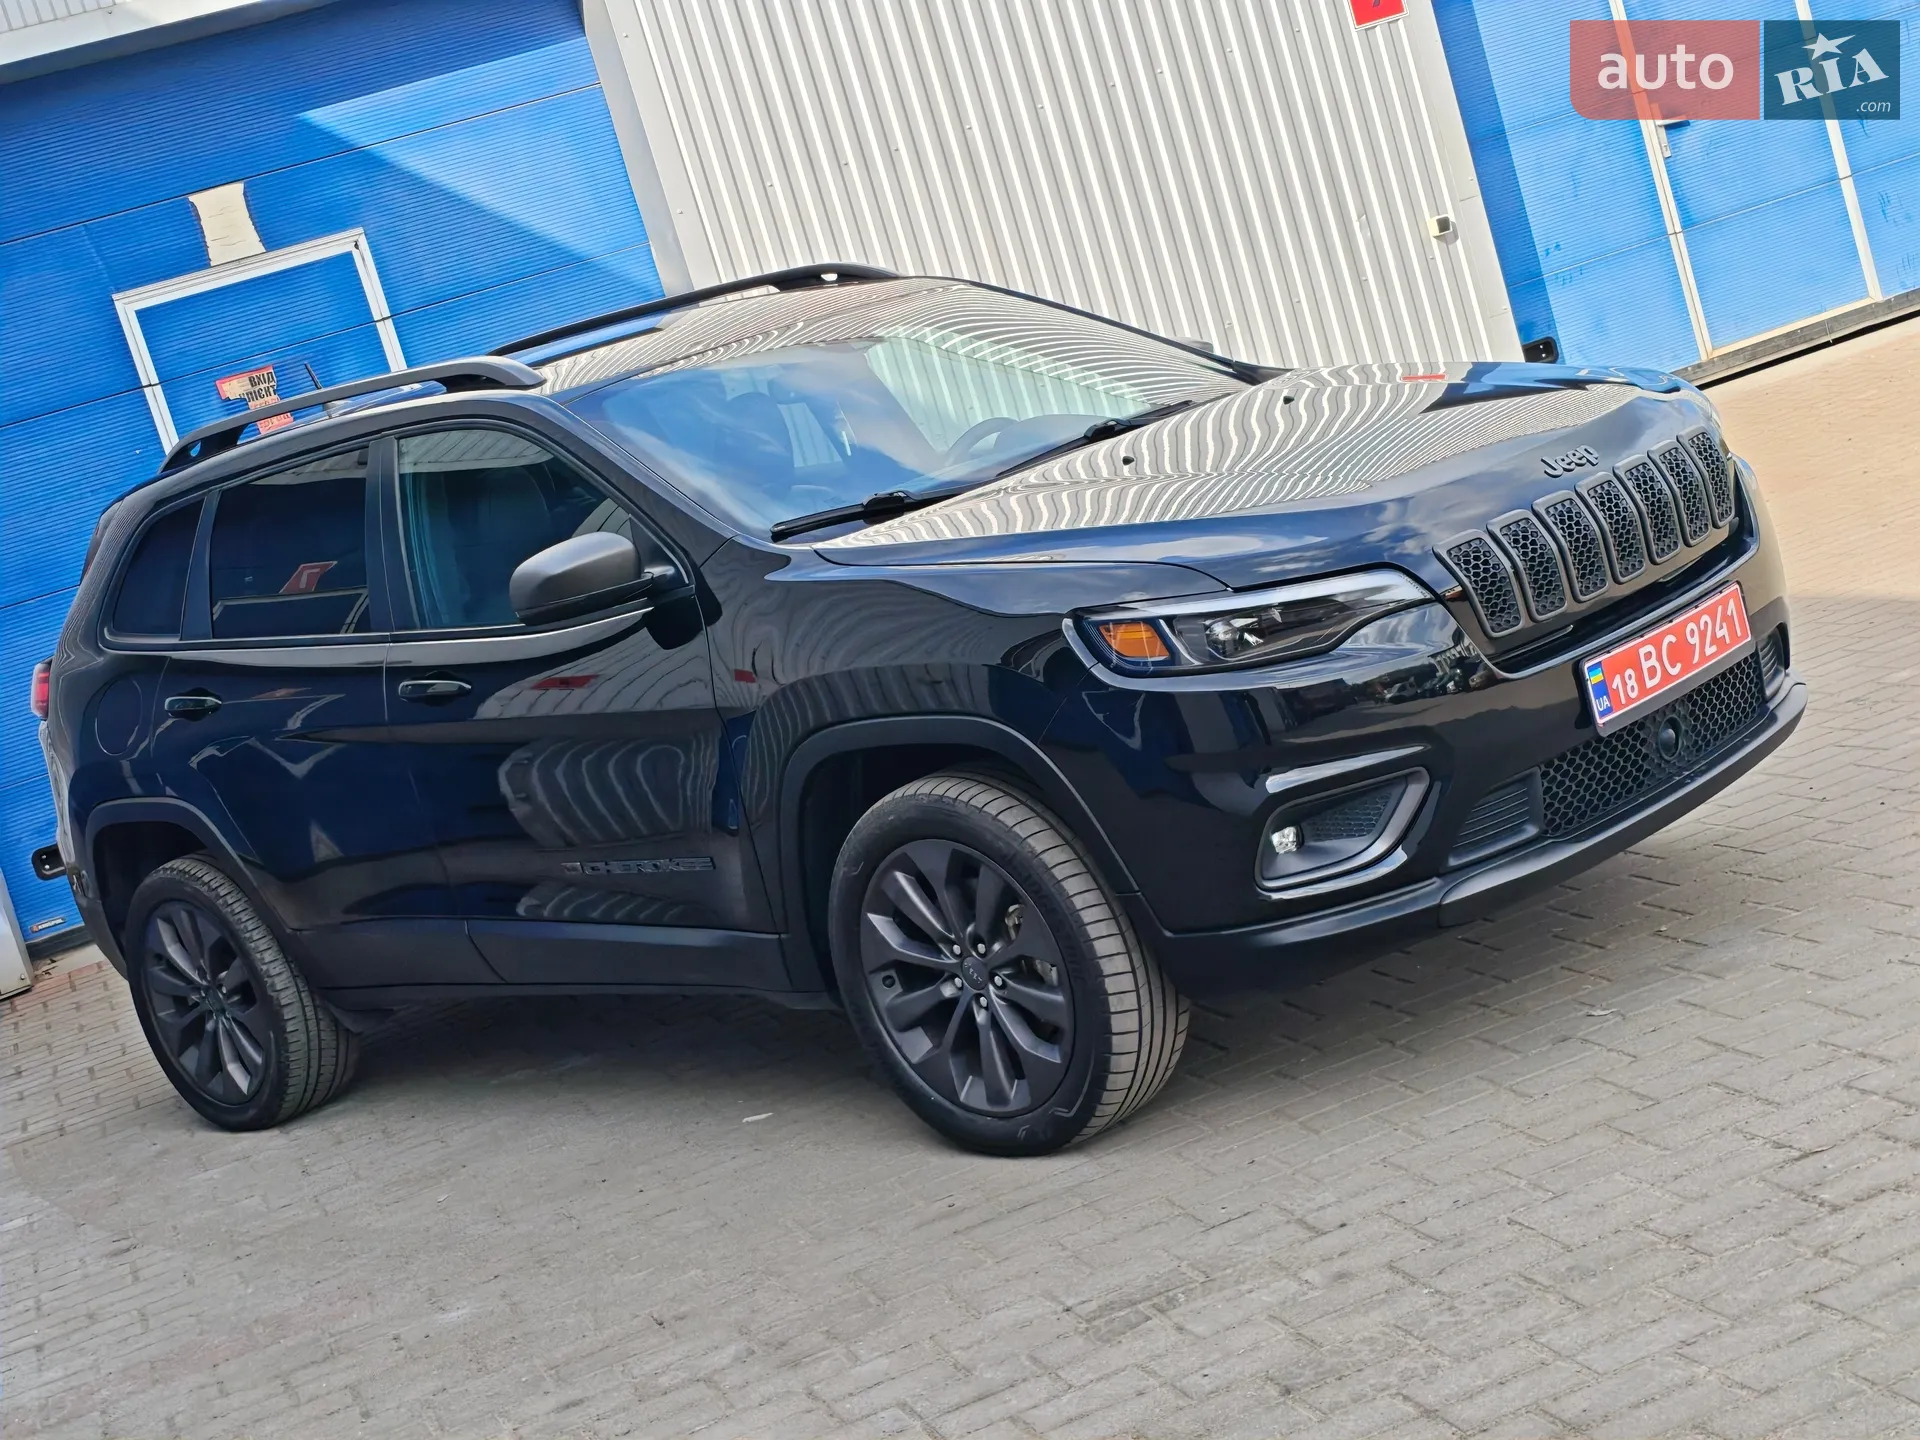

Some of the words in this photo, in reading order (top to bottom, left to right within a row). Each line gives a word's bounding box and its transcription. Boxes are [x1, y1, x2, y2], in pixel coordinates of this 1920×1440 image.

[248, 371, 276, 388] ВХІД
[1540, 445, 1600, 478] Jeep
[1612, 668, 1639, 704] 18
[1639, 634, 1682, 689] BC
[1685, 598, 1742, 664] 9241
[1596, 697, 1611, 712] UA
